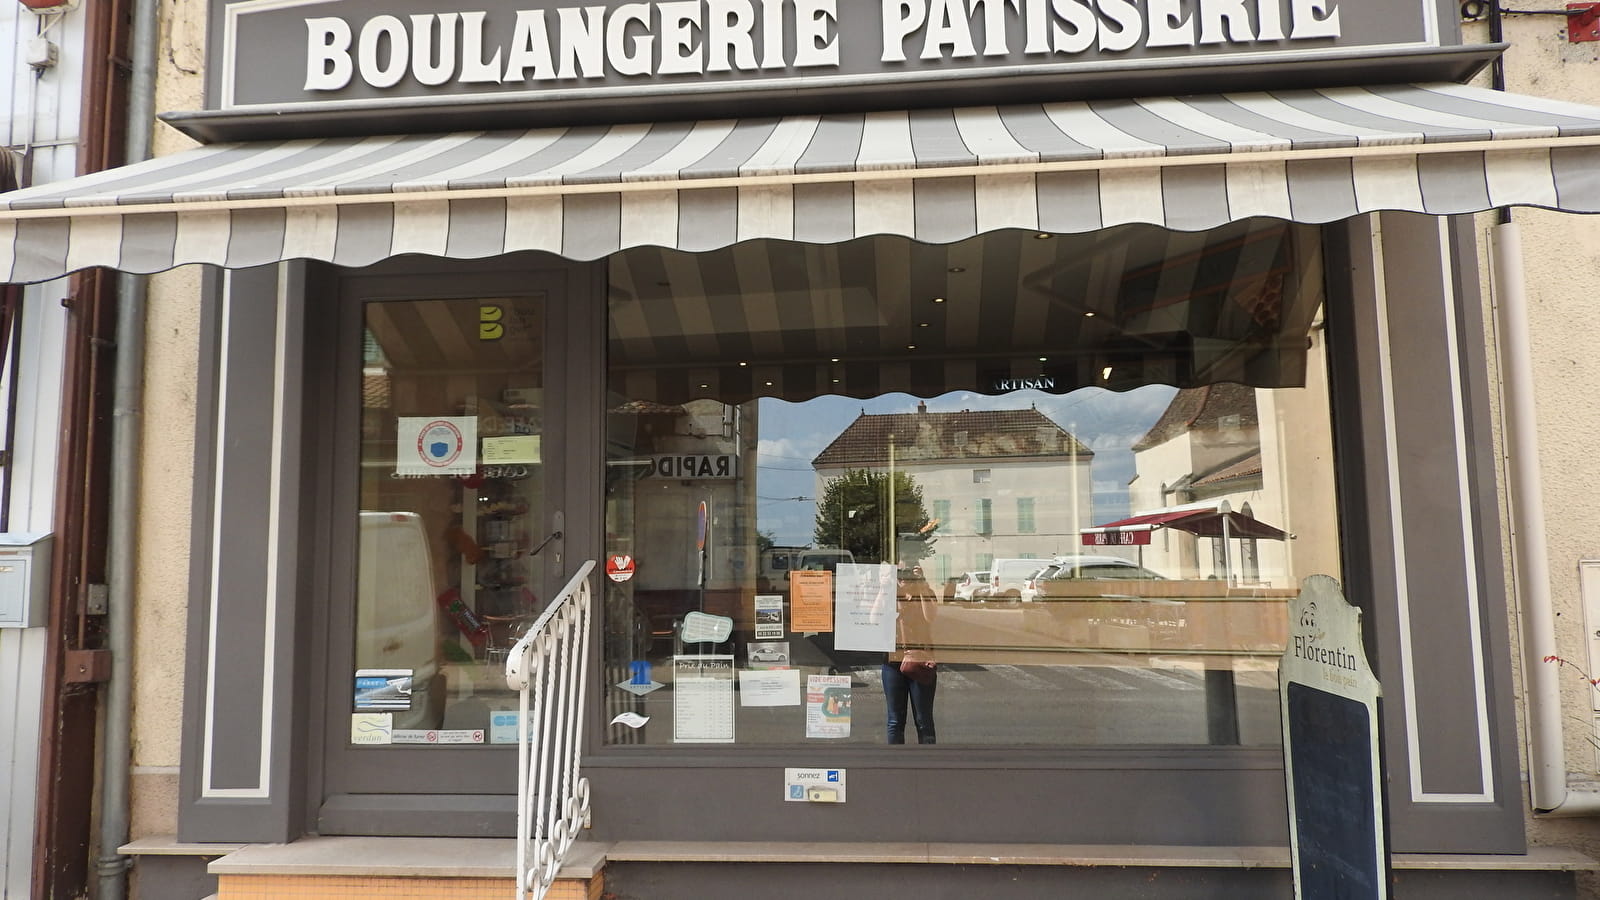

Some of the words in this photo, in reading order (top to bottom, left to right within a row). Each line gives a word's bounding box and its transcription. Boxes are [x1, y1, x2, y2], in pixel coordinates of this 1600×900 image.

[303, 0, 839, 92] BOULANGERIE
[710, 662, 729, 670] Pain
[1294, 635, 1357, 671] Florentin
